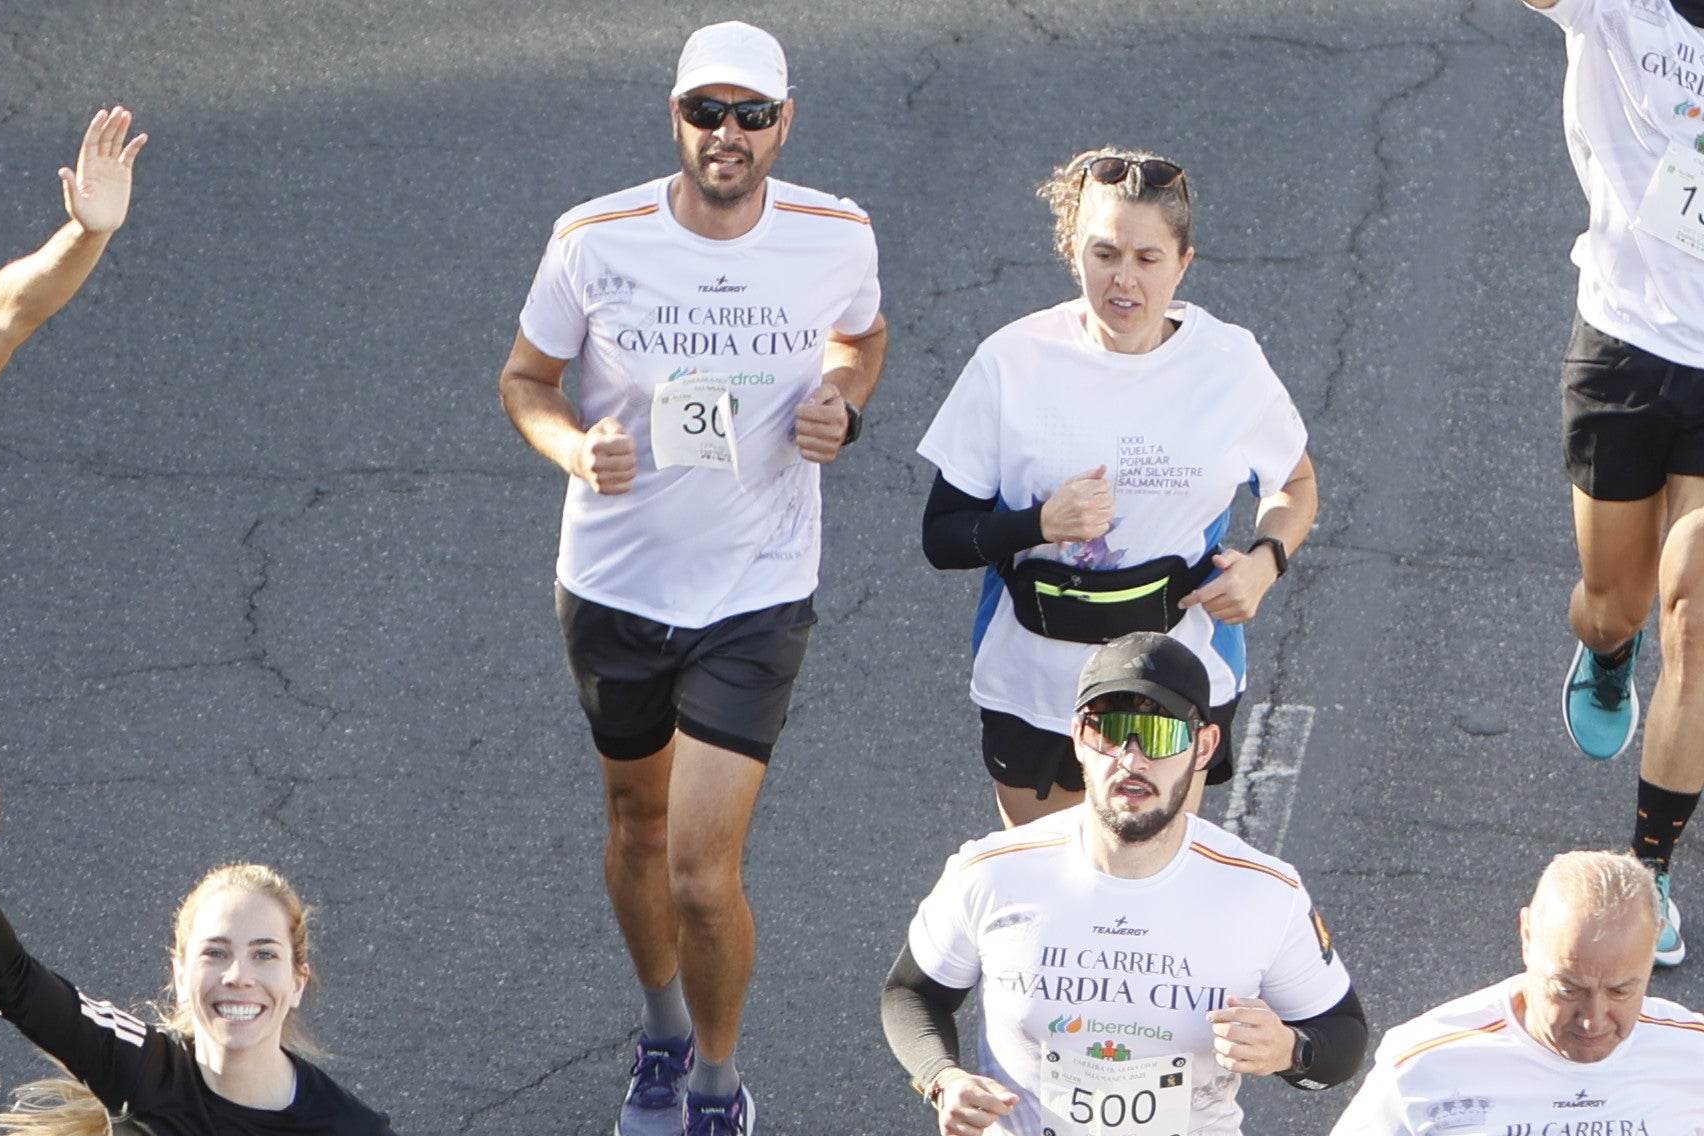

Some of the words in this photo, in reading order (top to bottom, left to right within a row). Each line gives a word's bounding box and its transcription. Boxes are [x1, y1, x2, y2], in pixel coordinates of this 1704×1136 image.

[1681, 186, 1704, 225] 1
[656, 305, 680, 325] III
[688, 305, 790, 329] CARRERA
[616, 328, 741, 358] GVARDIA
[1119, 444, 1165, 456] VUELTA
[1119, 455, 1170, 467] POPULAR
[1117, 477, 1190, 488] SALMANTINA
[1119, 467, 1142, 478] SAN
[1145, 466, 1204, 478] SILVESTRE
[1040, 945, 1068, 969] III
[1076, 948, 1193, 979] CARRERA
[1086, 1018, 1174, 1042] Iberdrola
[1069, 1086, 1158, 1128] 500
